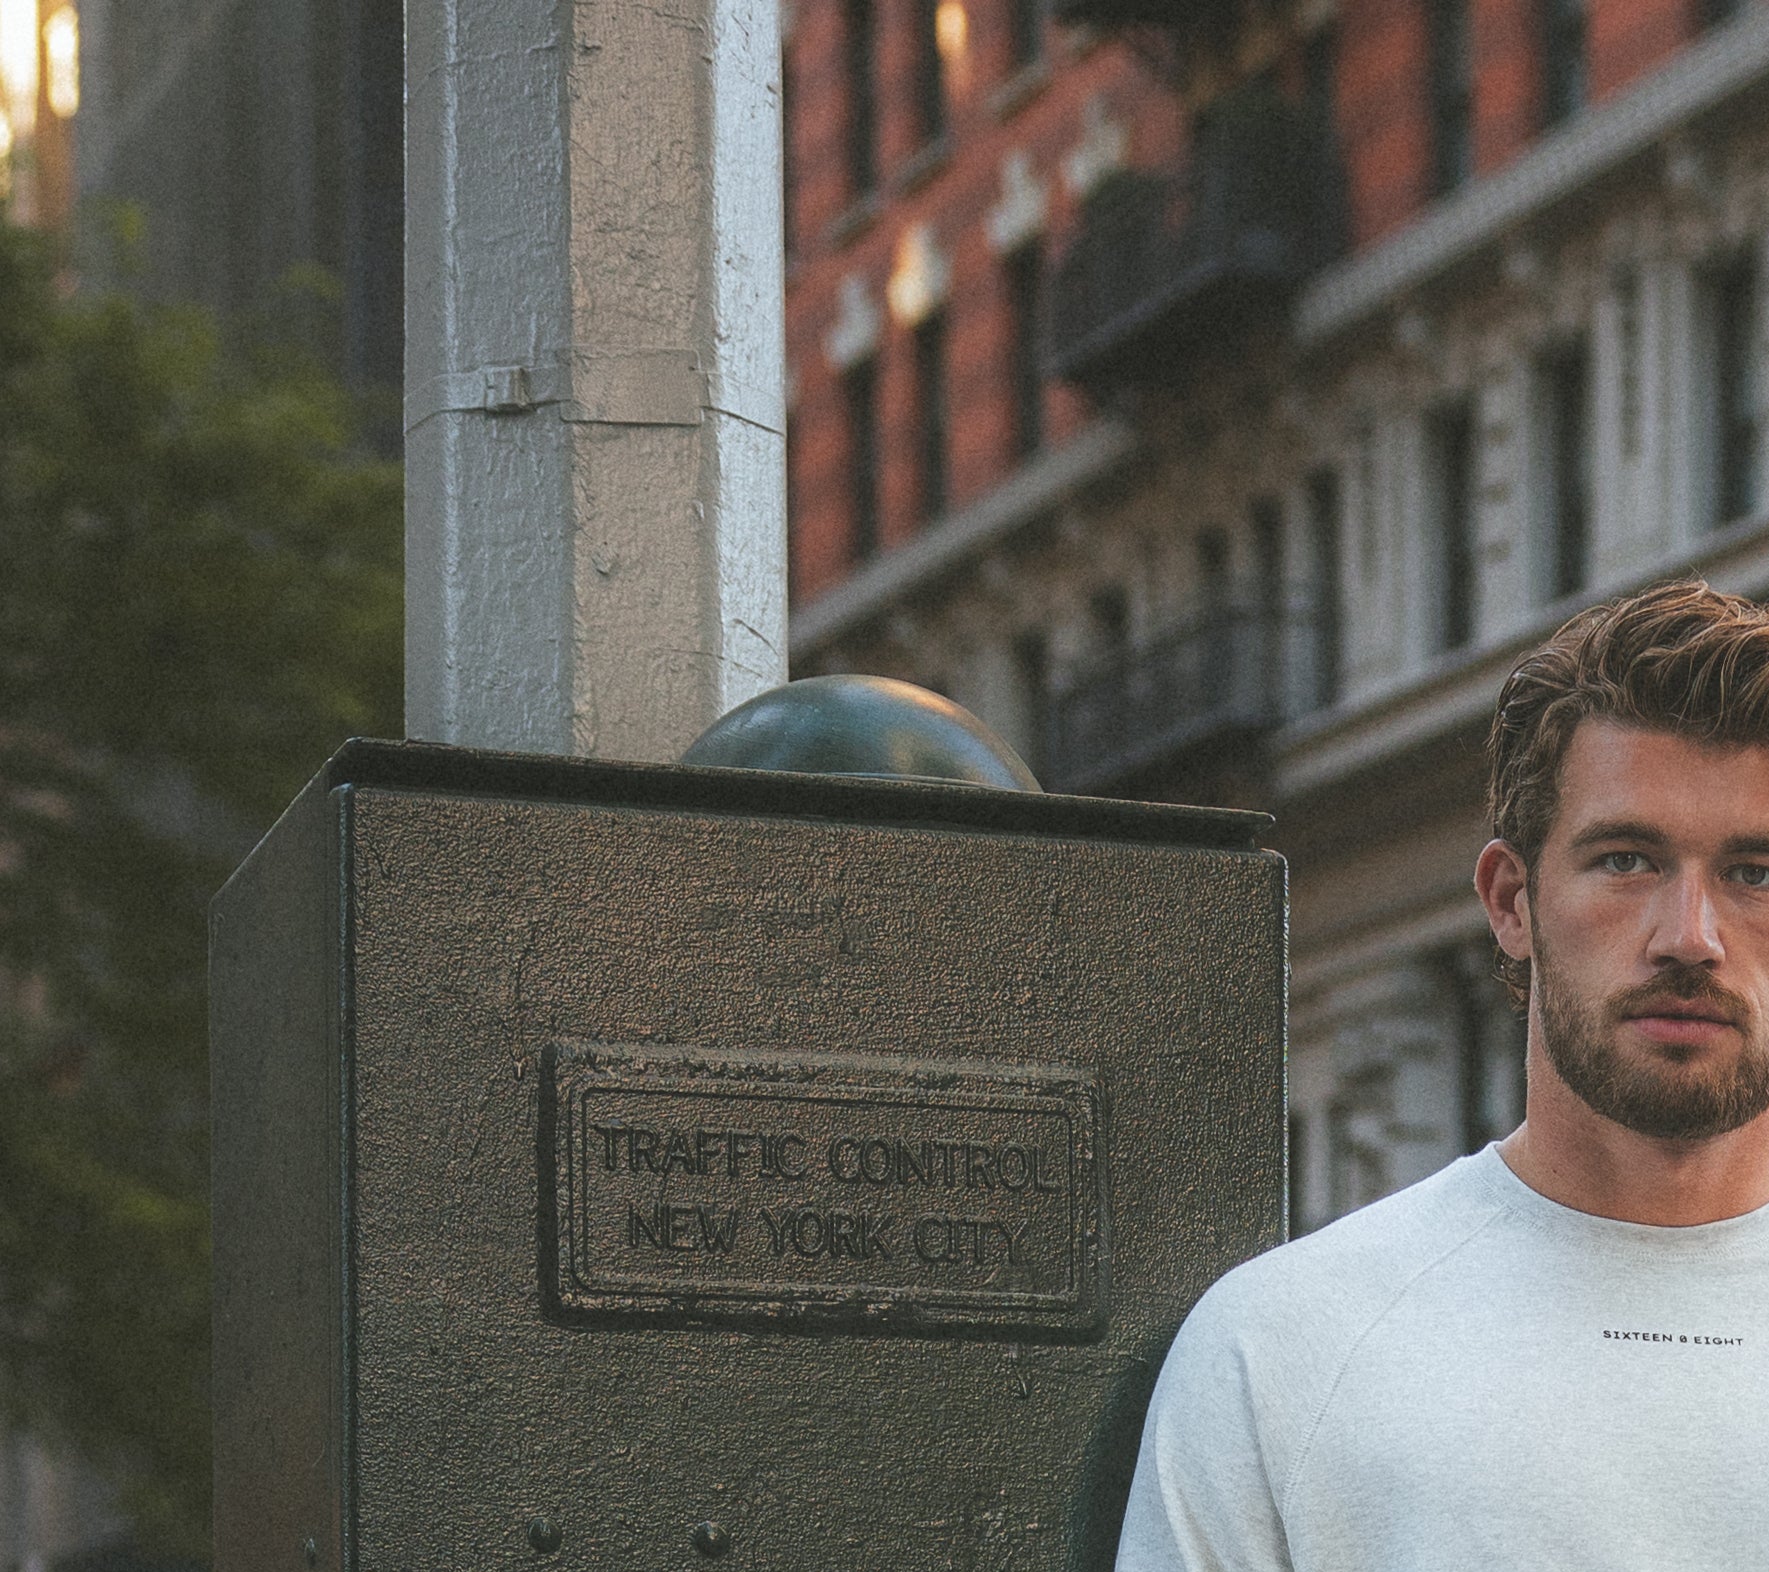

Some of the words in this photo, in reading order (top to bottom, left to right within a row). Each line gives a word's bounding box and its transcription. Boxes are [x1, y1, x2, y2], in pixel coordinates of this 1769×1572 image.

[592, 1124, 806, 1181] TRAFFIC
[828, 1133, 1063, 1193] CONTROL
[628, 1201, 740, 1252] NEW
[759, 1206, 894, 1260] YORK
[912, 1211, 1030, 1264] CITY
[1602, 1329, 1673, 1343] SIXTEEN
[1693, 1335, 1744, 1347] EIGHT
